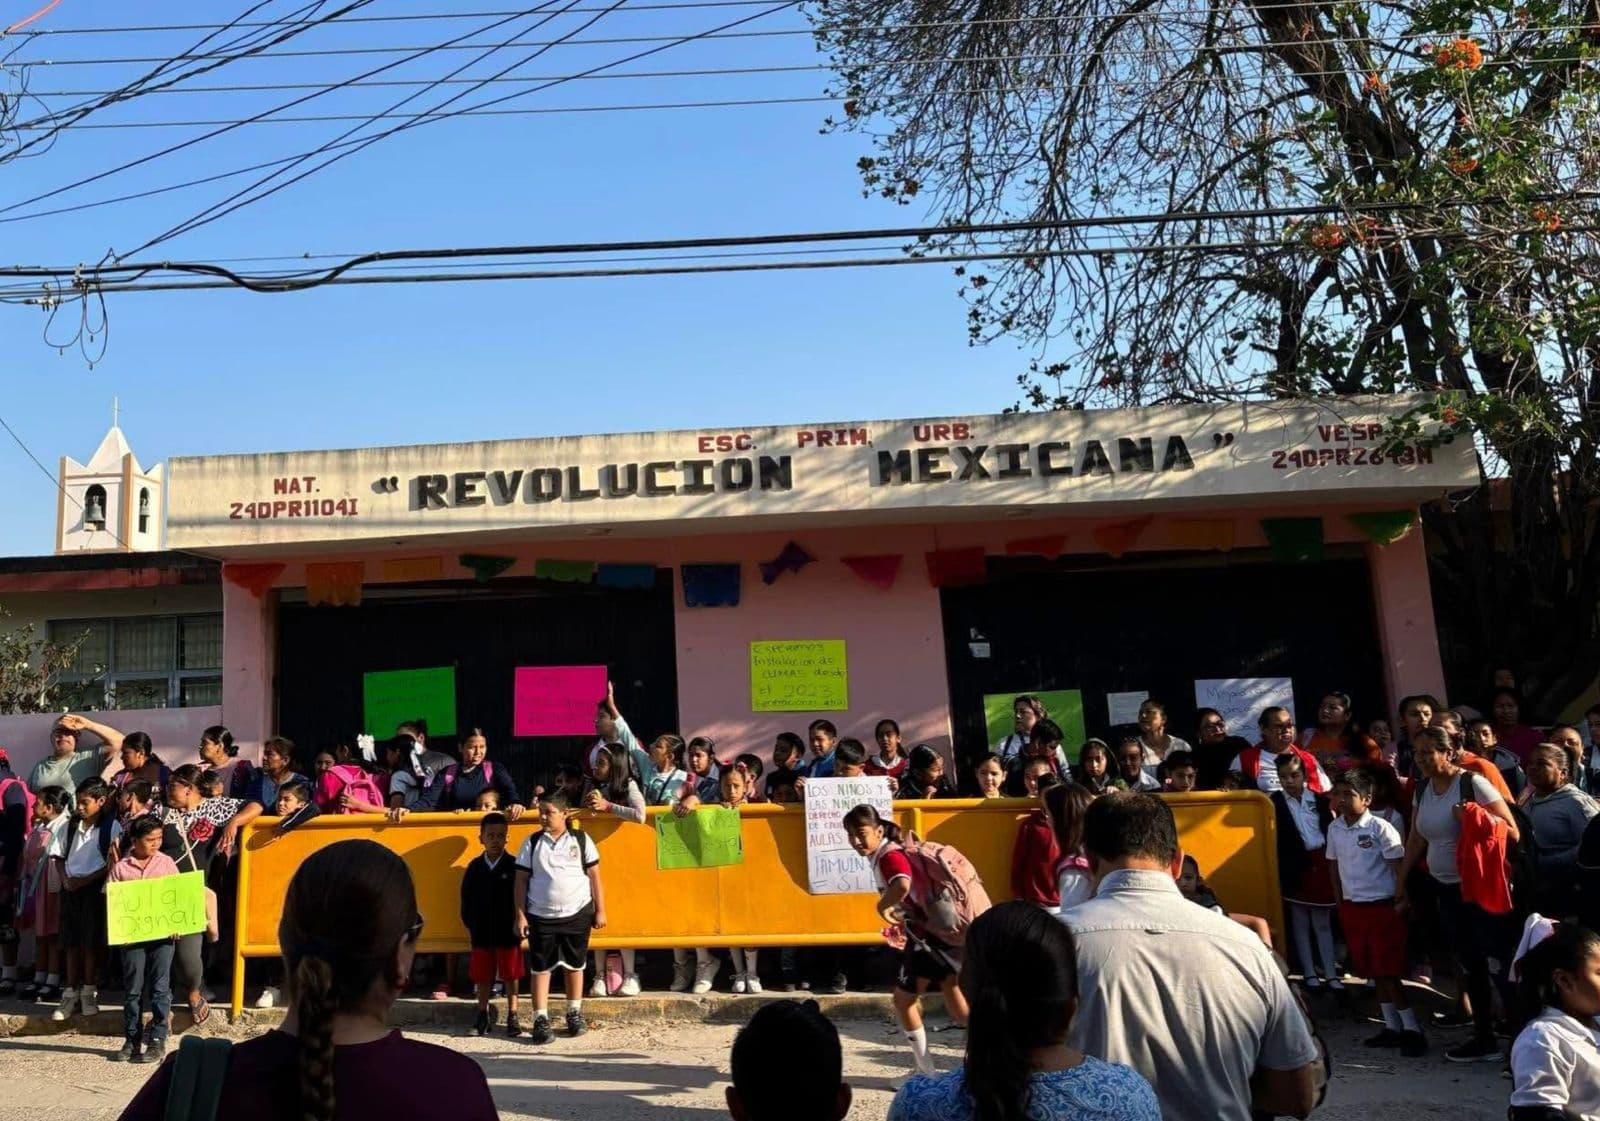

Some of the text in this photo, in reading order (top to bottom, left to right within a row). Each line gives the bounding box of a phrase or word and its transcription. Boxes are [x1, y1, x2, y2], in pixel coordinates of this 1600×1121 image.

[698, 422, 975, 453] ESC. PRIM. URB.
[274, 476, 320, 495] MAT.
[229, 498, 358, 520] 24DPR1104I
[807, 784, 828, 797] LOS
